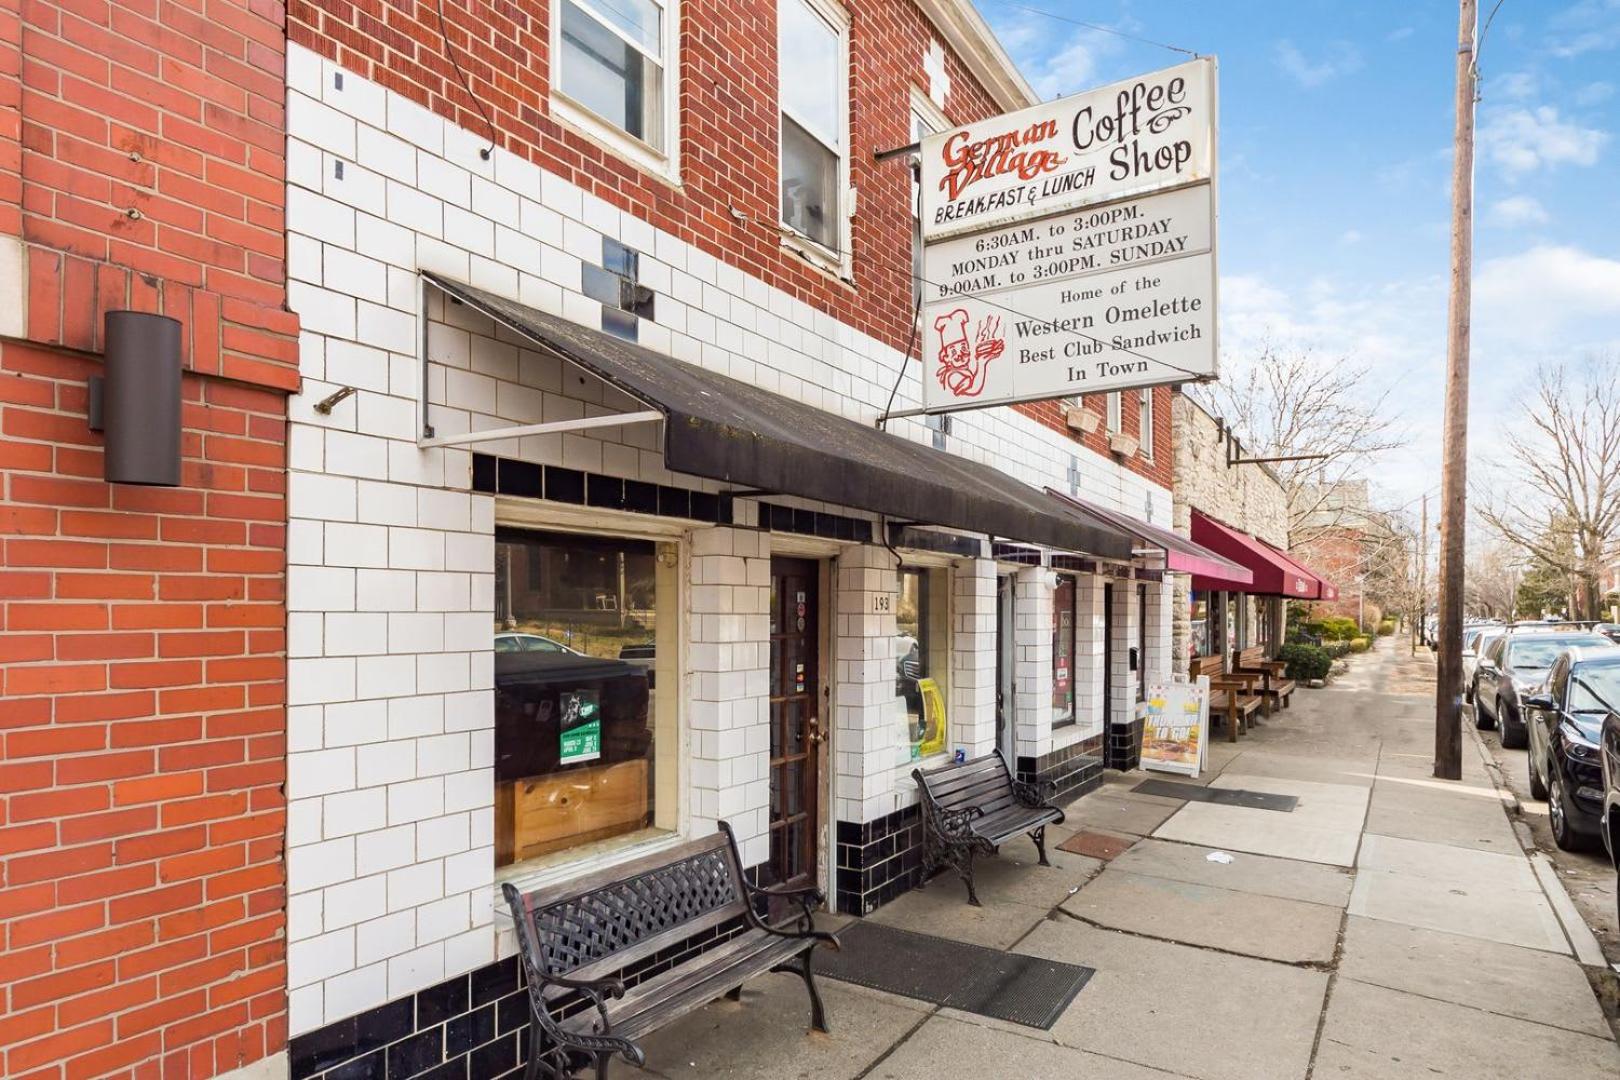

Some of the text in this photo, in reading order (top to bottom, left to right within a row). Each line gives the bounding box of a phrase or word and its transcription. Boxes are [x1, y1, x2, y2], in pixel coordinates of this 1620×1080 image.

[1072, 77, 1185, 150] Coffee
[943, 119, 1058, 167] German
[1110, 139, 1191, 180] Shop
[934, 186, 1025, 223] BREAKFAST
[1042, 168, 1095, 197] LUNCH
[939, 148, 1068, 202] Village
[952, 218, 1172, 277] MONDAY thru SATURDAY
[976, 205, 1144, 252] 6:30AM. to 3:00PM.
[940, 236, 1188, 297] 9:00AM. to 3:00PM. SUNDAY
[1061, 277, 1161, 304] Home of the
[1015, 297, 1202, 338] Western Omelette
[1019, 323, 1202, 364] Best Club Sandwich
[1067, 361, 1148, 382] In Town
[875, 596, 889, 610] 193
